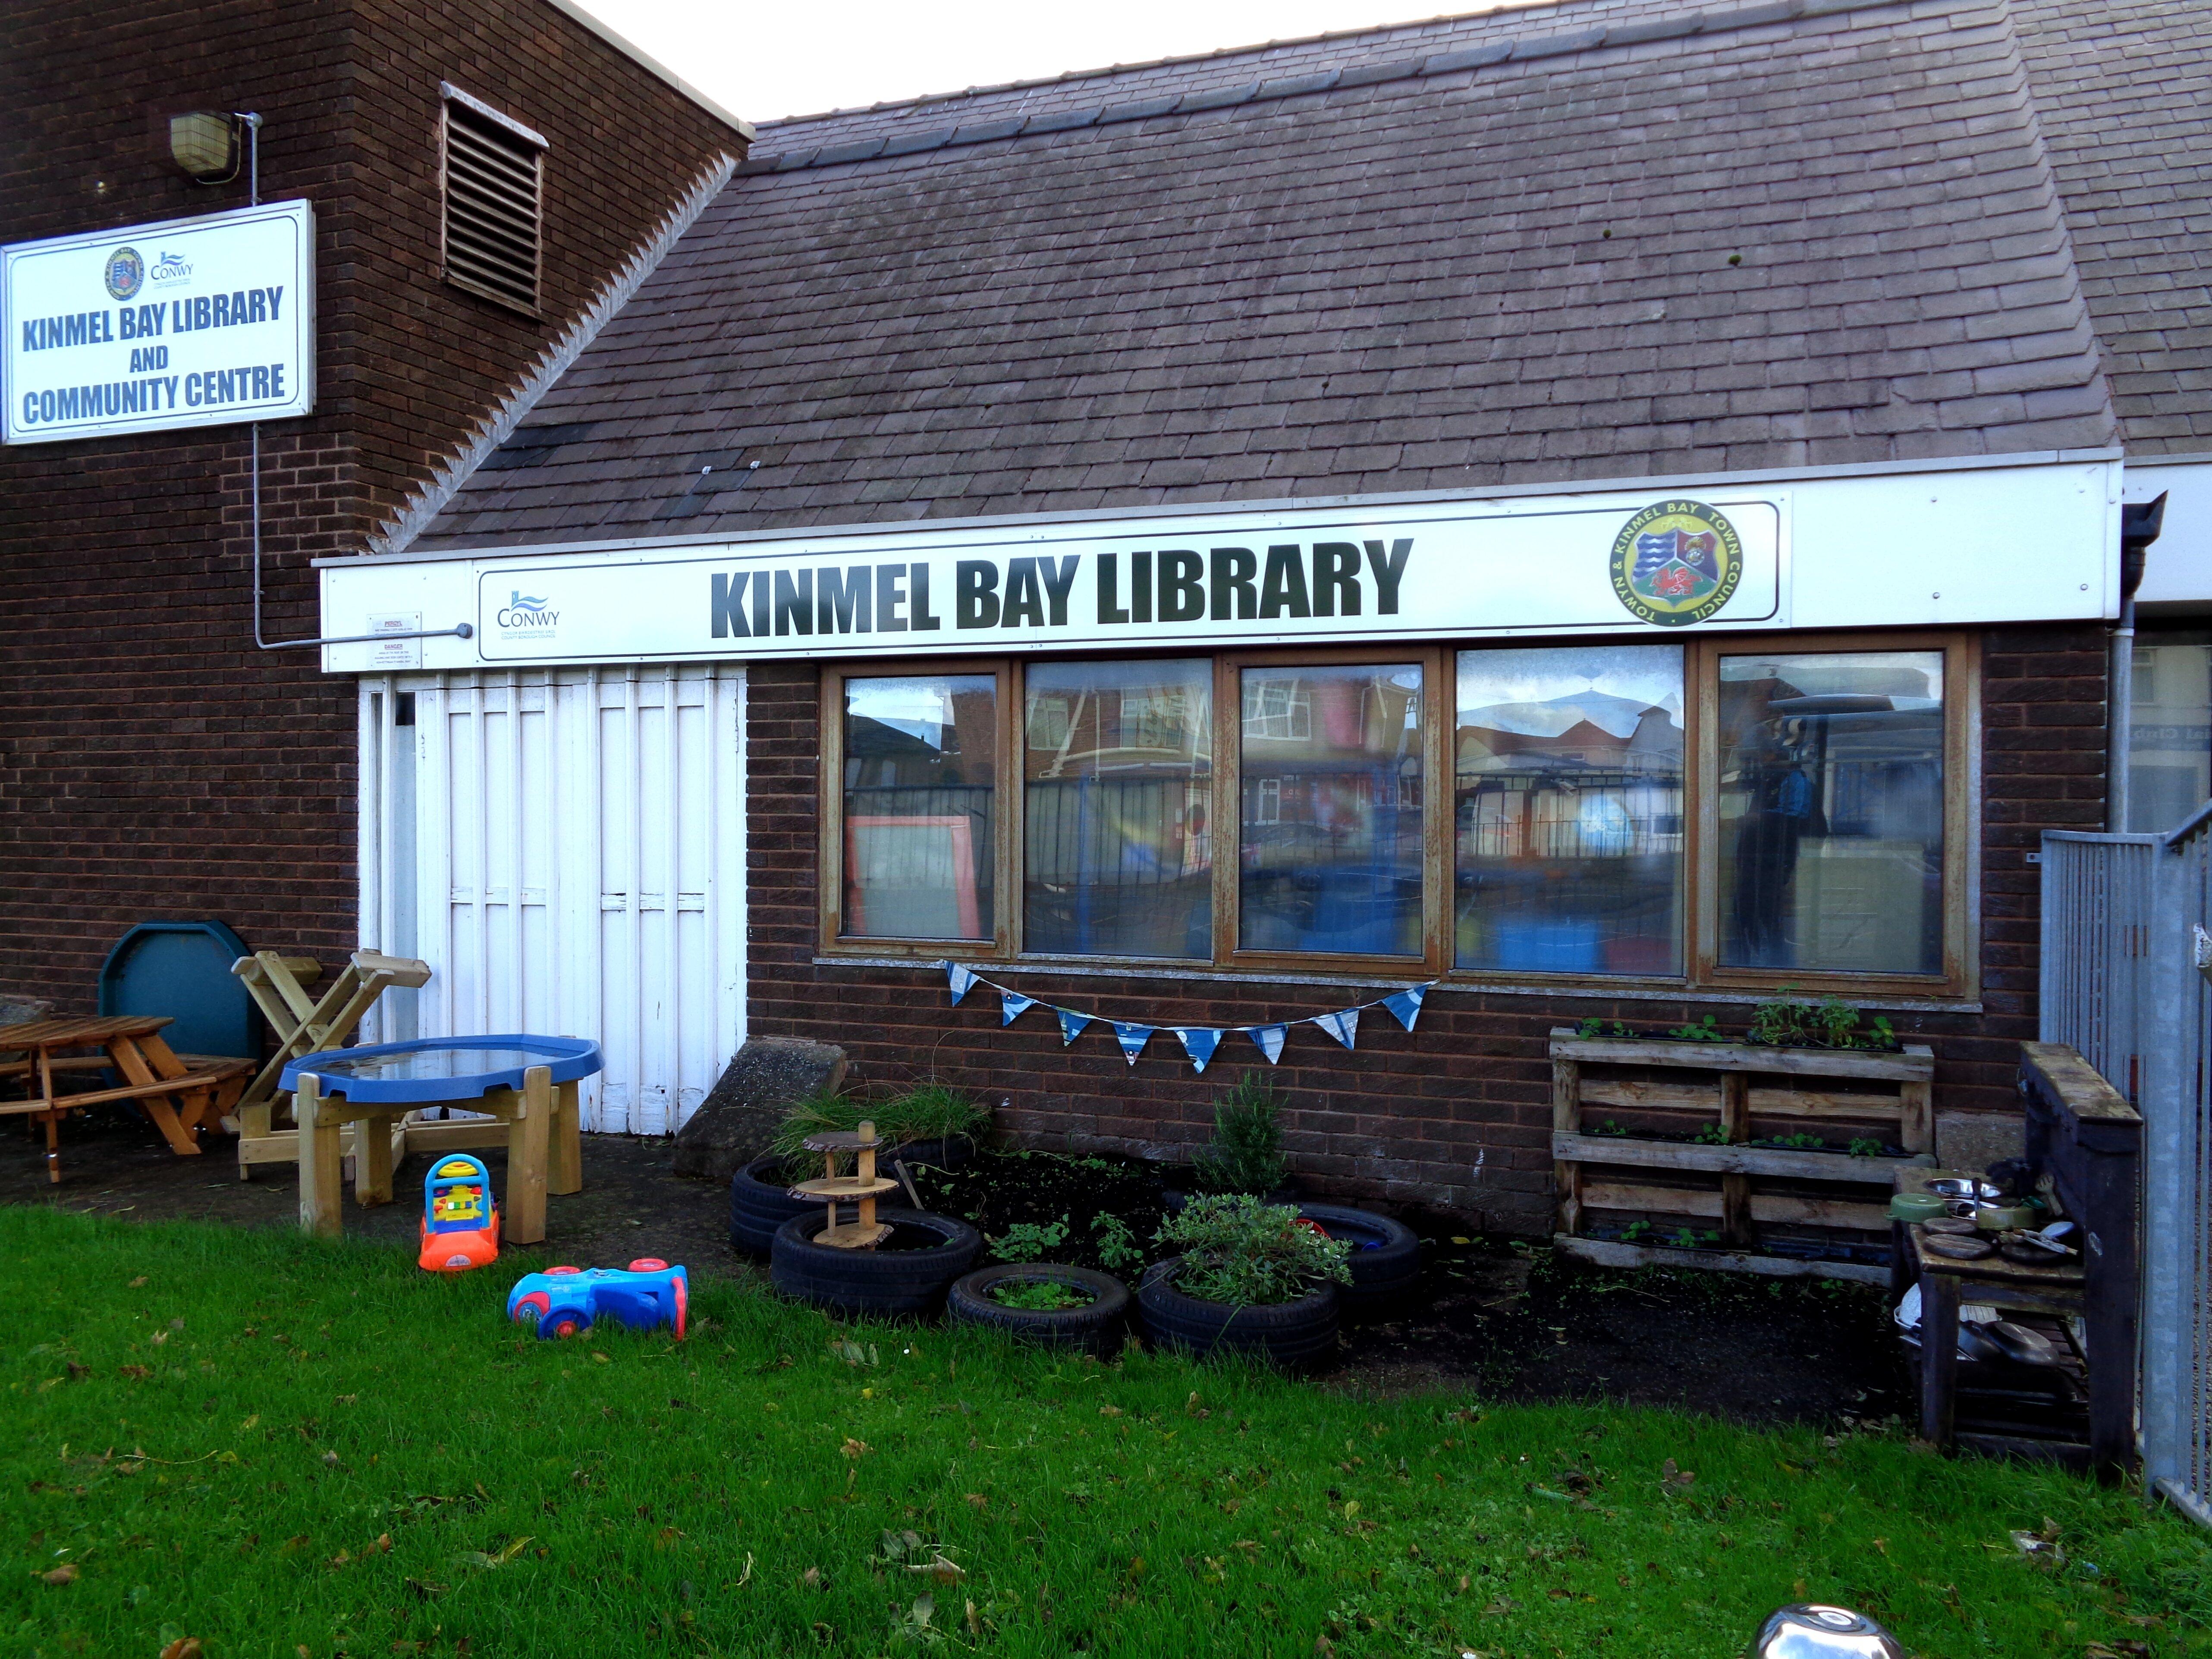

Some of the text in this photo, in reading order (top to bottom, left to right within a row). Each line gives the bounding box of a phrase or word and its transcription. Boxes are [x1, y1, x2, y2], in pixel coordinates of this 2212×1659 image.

[23, 286, 283, 352] KINMEL BAY LIBRARY
[129, 345, 168, 373] AND
[23, 363, 285, 424] COMMUNITY CENTRE
[711, 538, 1414, 638] KINMEL BAY LIBRARY
[1613, 503, 1741, 622] TOWYN & KINMEL BAY TOWN COUNCIL
